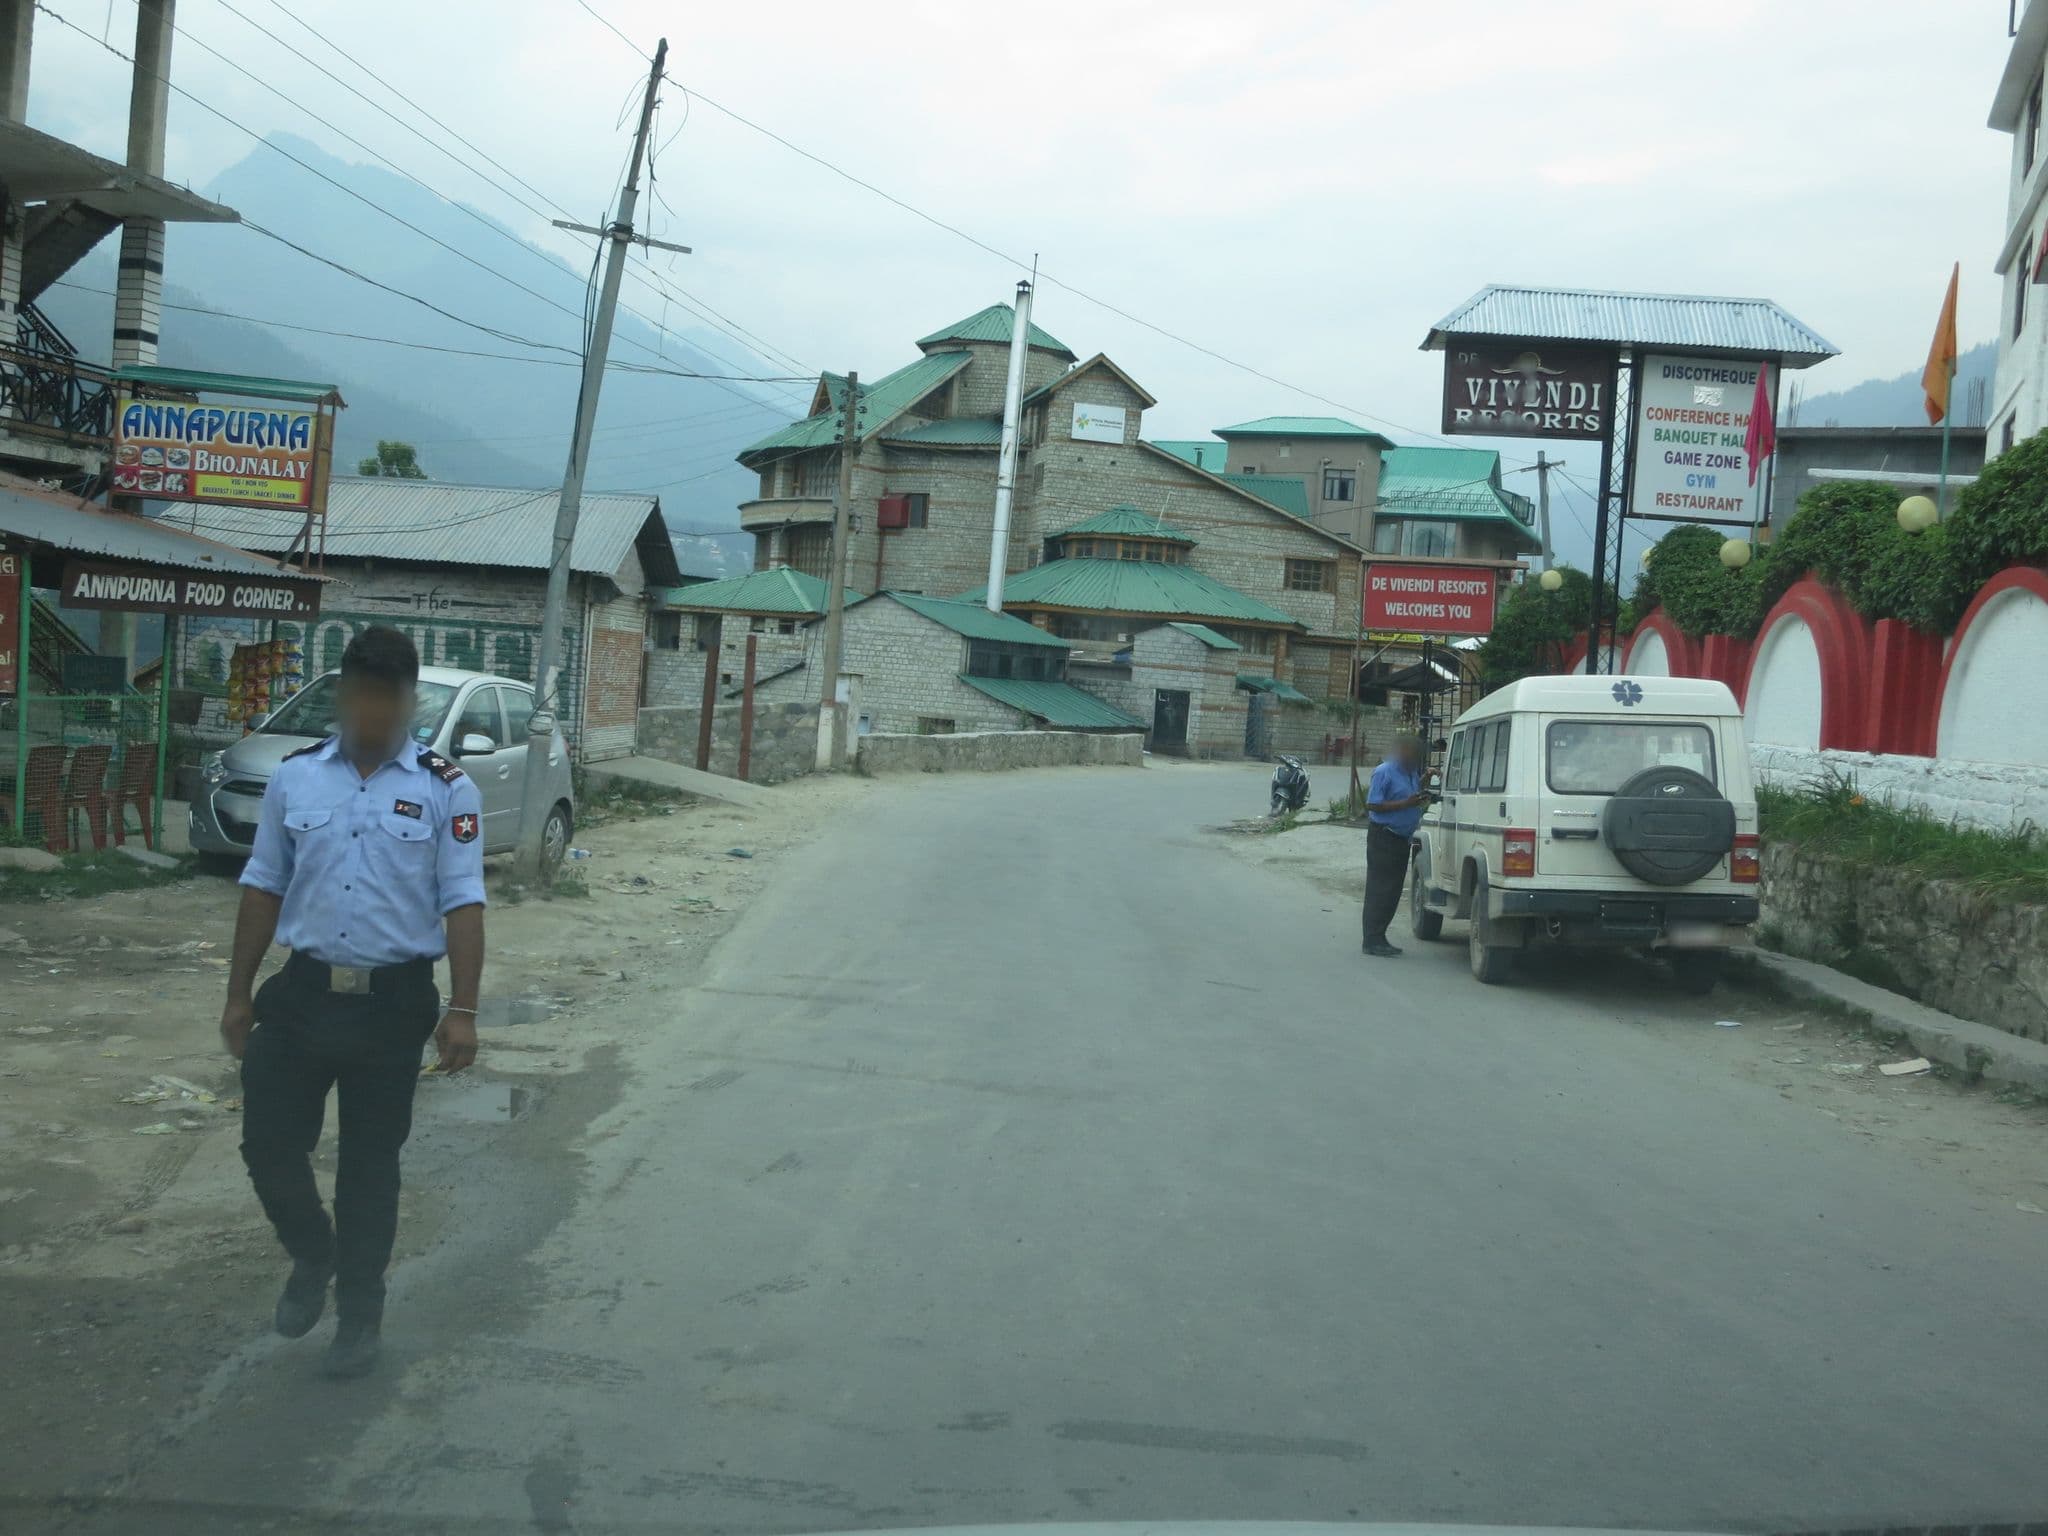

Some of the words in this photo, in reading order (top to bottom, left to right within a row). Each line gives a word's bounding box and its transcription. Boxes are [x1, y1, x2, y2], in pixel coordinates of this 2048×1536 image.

[1662, 365, 1758, 385] DISCOTHEQUE
[1465, 377, 1602, 411] VIVENDI
[1646, 406, 1731, 426] CONFERENCE
[121, 403, 311, 452] ANNAPURNA
[1653, 428, 1718, 446] BANQUET
[194, 449, 312, 479] BHOJNALAY
[1664, 450, 1702, 466] GAME
[1705, 454, 1742, 469] ZONE
[1686, 473, 1717, 489] GYM
[1655, 492, 1744, 512] RESTAURANT
[73, 573, 177, 603] ANNPURNA
[184, 581, 226, 607] FOOD
[1371, 577, 1387, 591] DE
[1390, 578, 1435, 593] VIVENDI
[1438, 580, 1488, 596] RESORTS
[1385, 602, 1445, 618] WELCOMES
[1448, 604, 1472, 619] YOU
